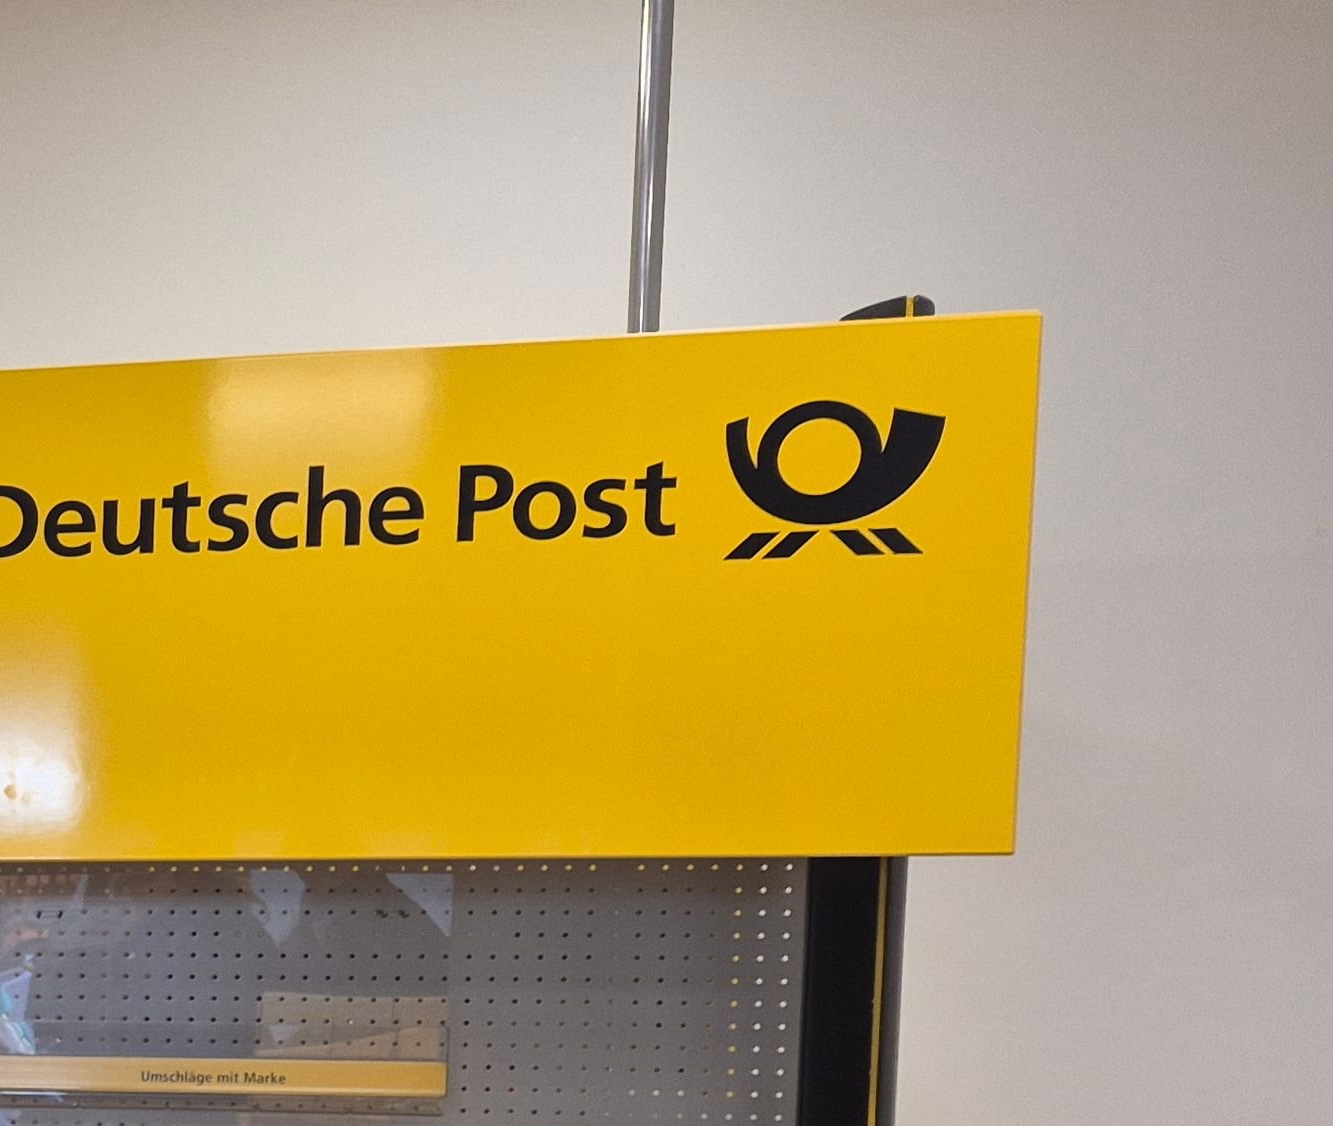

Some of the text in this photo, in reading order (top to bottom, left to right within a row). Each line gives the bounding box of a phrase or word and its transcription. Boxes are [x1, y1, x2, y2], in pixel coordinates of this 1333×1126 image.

[456, 461, 677, 544] Post
[140, 1070, 286, 1085] Umschläge mit Marke
